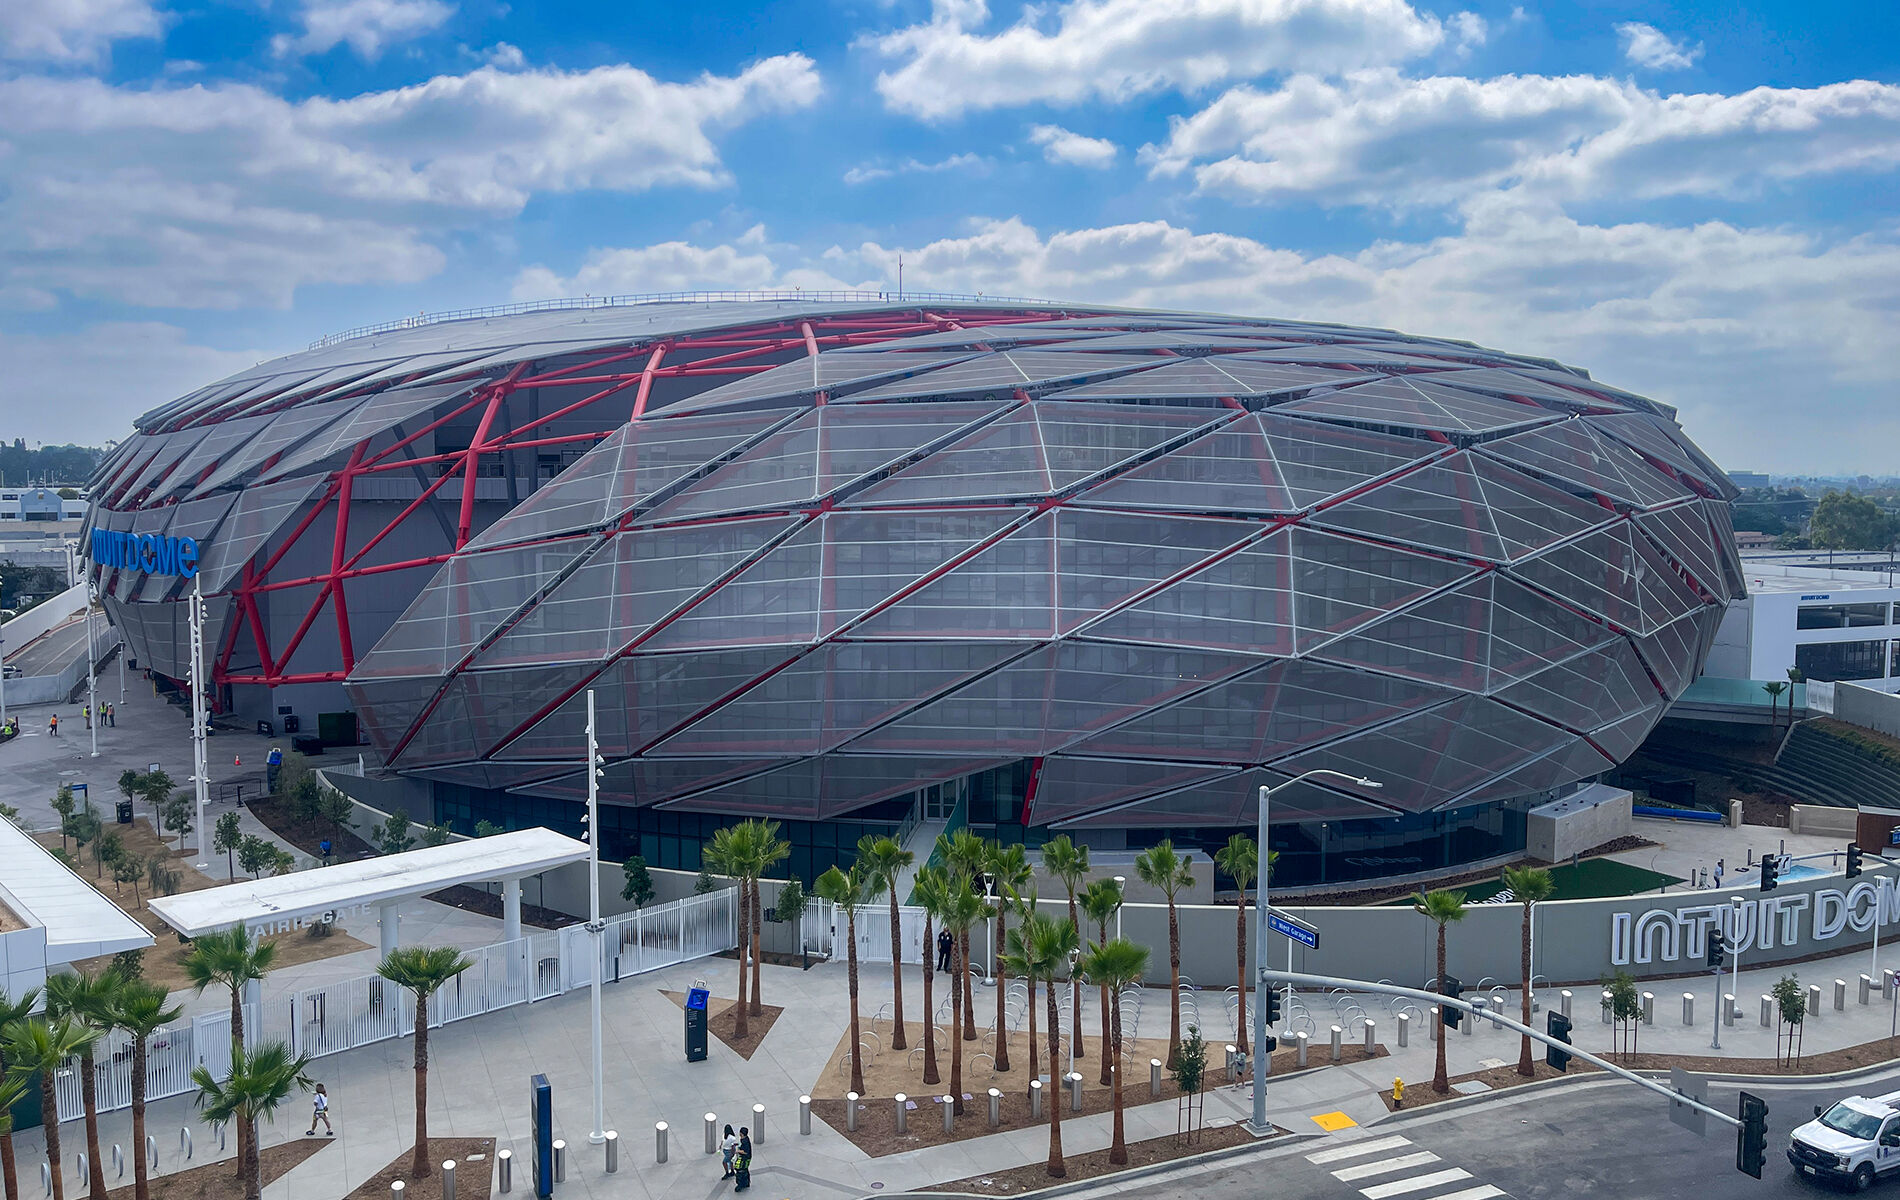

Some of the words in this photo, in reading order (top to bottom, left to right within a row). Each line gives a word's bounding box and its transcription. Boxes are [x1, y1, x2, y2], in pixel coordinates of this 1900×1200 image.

[243, 913, 314, 939] AIRIE
[321, 903, 371, 924] GATE
[1279, 922, 1290, 933] West
[1290, 927, 1307, 941] Garage
[1612, 893, 1810, 965] INTUIT
